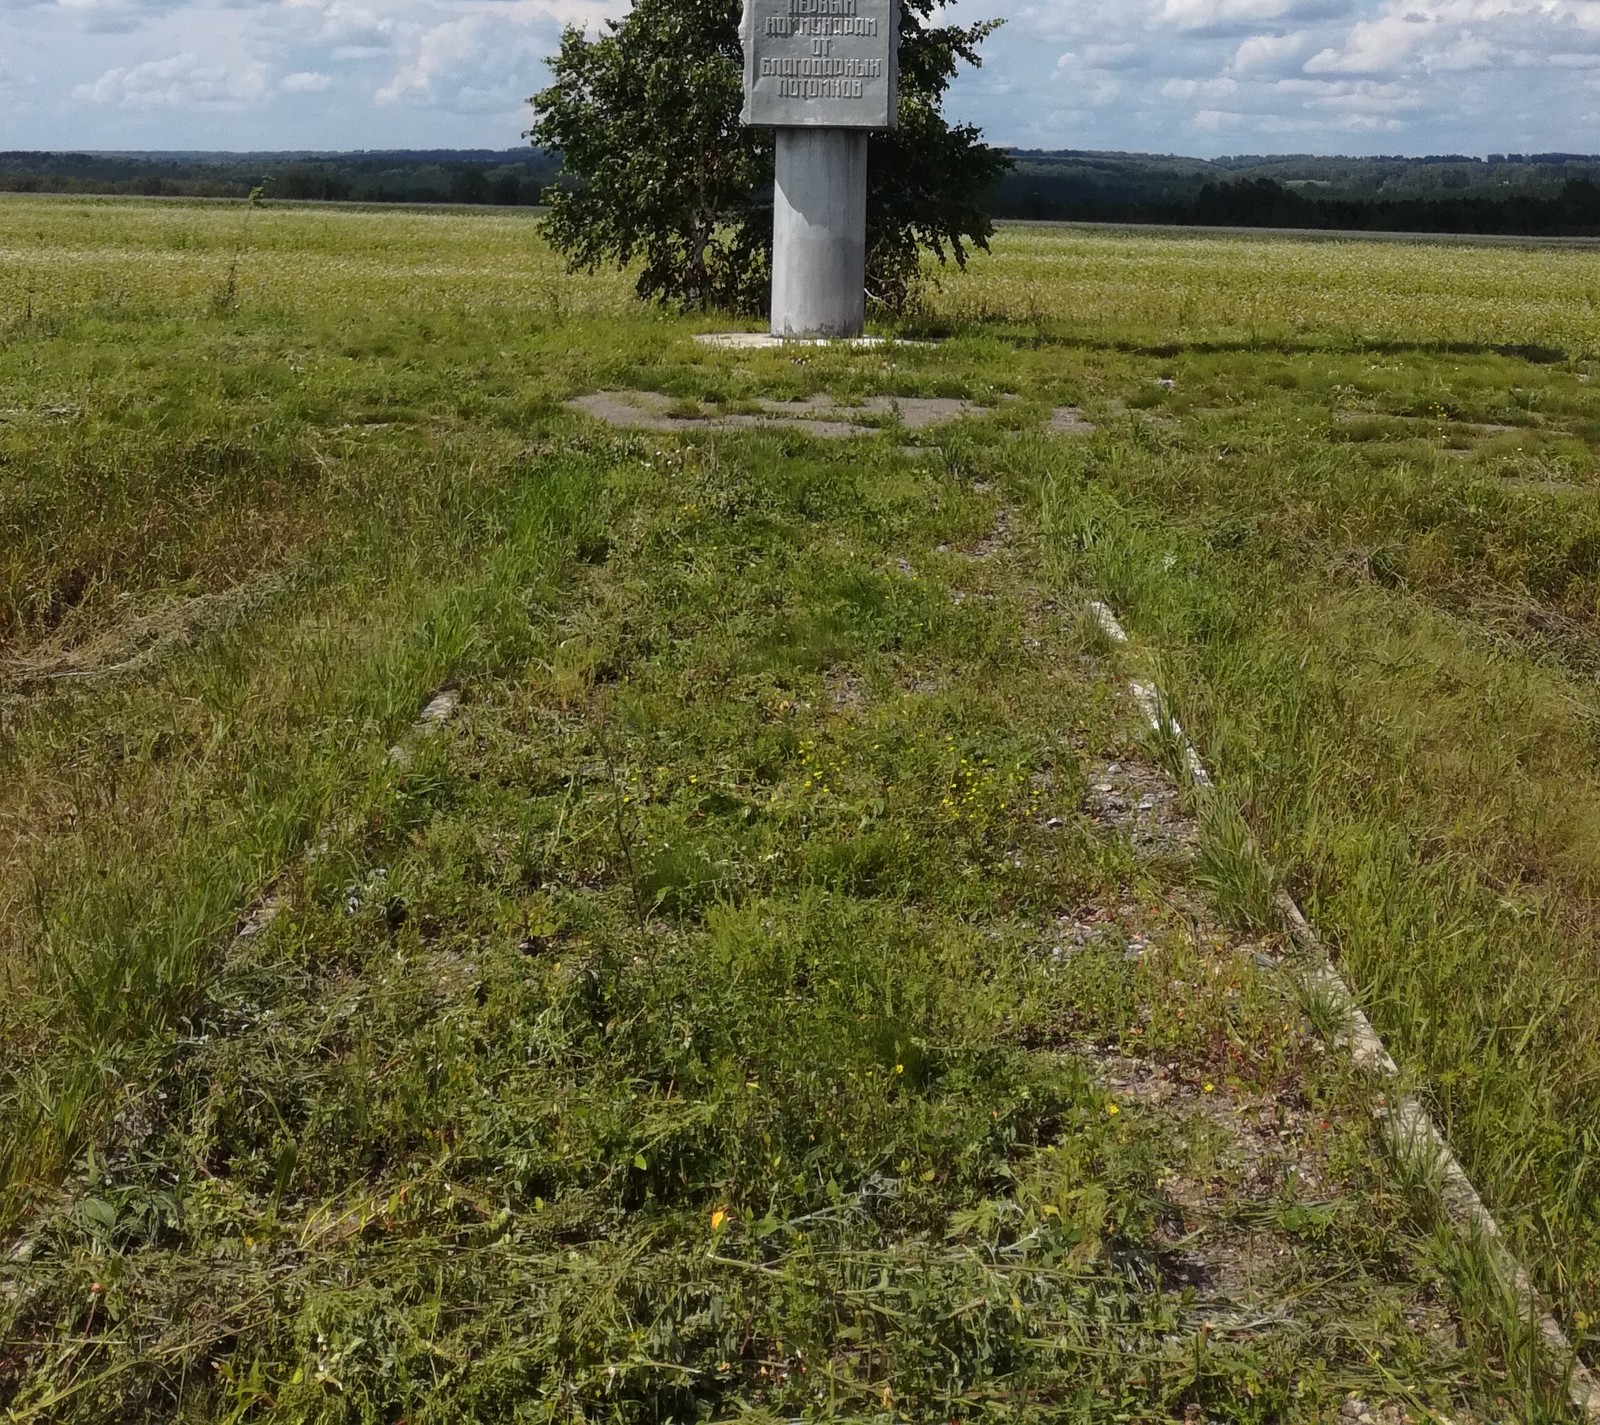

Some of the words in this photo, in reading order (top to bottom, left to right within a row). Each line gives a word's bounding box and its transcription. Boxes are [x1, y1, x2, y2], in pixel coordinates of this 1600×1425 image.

[811, 37, 832, 56] ОТ
[761, 57, 883, 77] БЛАГОДАРНЫХ
[778, 78, 863, 98] ПОТОМКОВ
